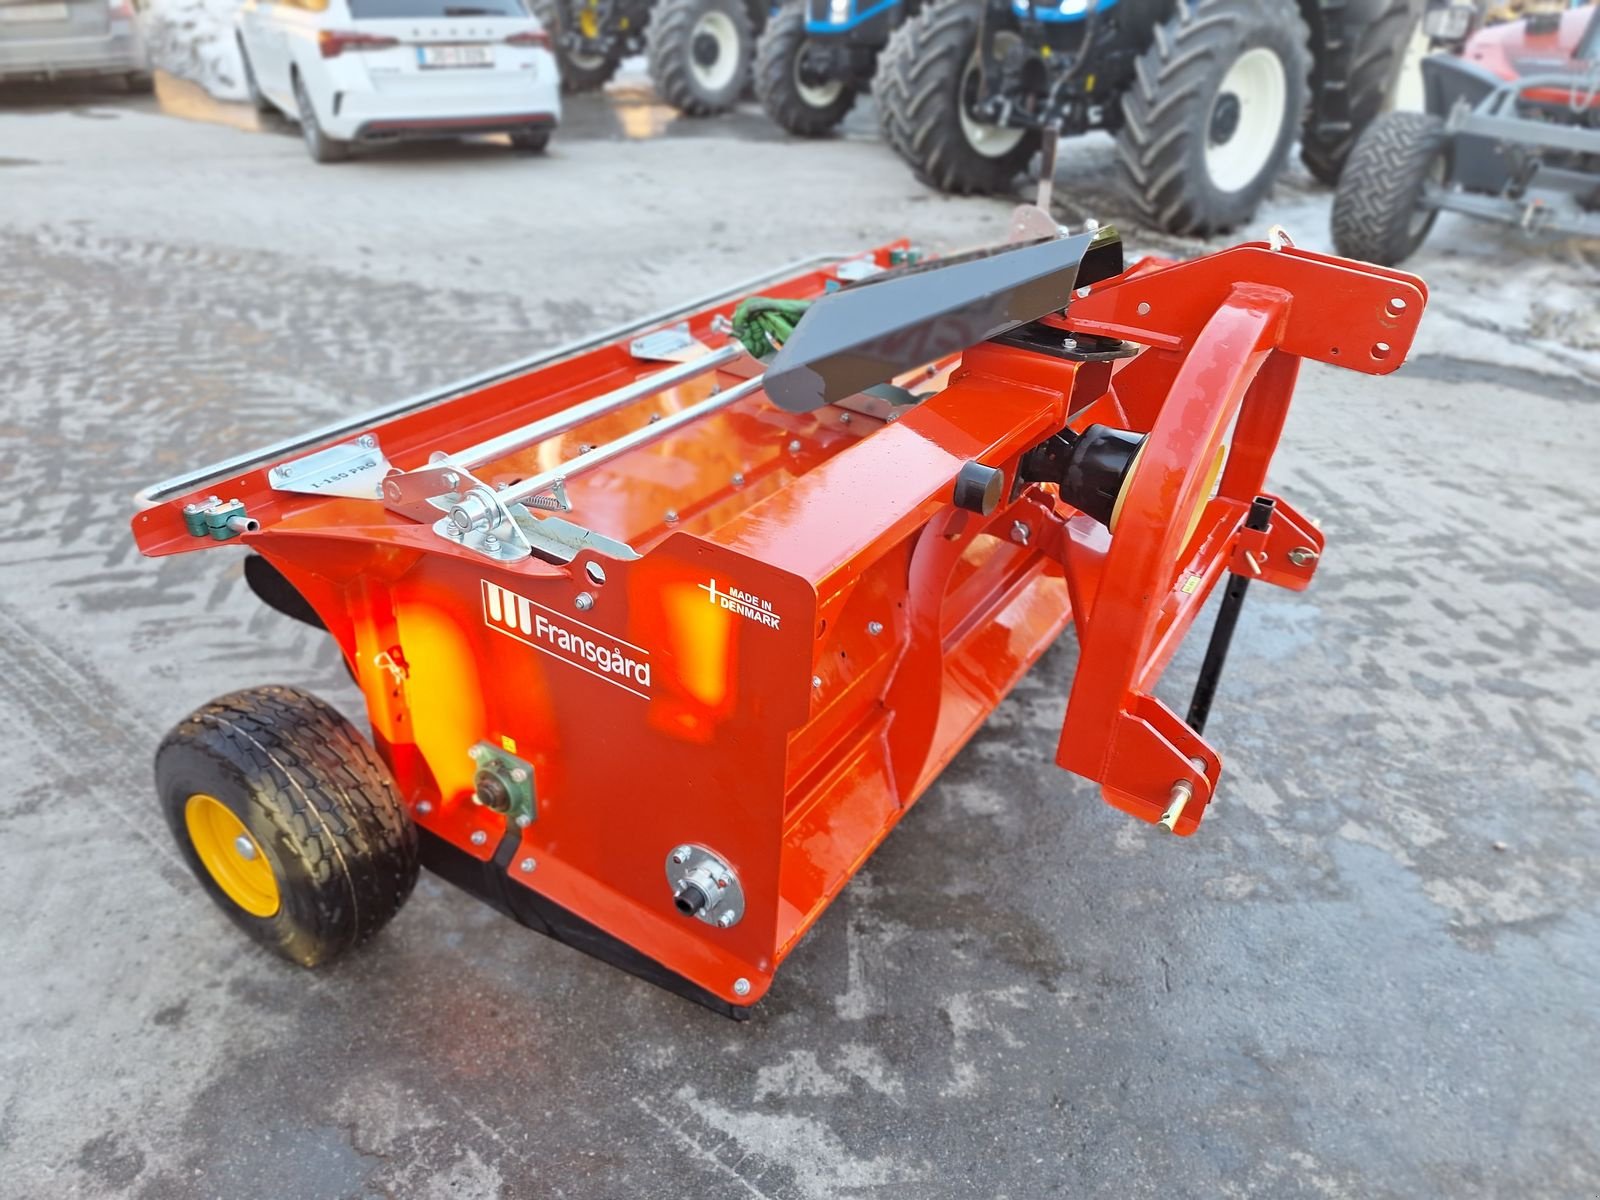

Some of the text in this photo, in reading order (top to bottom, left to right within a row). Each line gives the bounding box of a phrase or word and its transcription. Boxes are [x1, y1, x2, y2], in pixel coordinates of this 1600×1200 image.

[720, 596, 780, 630] DENMARK
[729, 586, 772, 612] MADE IN
[535, 614, 651, 687] Fransgård
